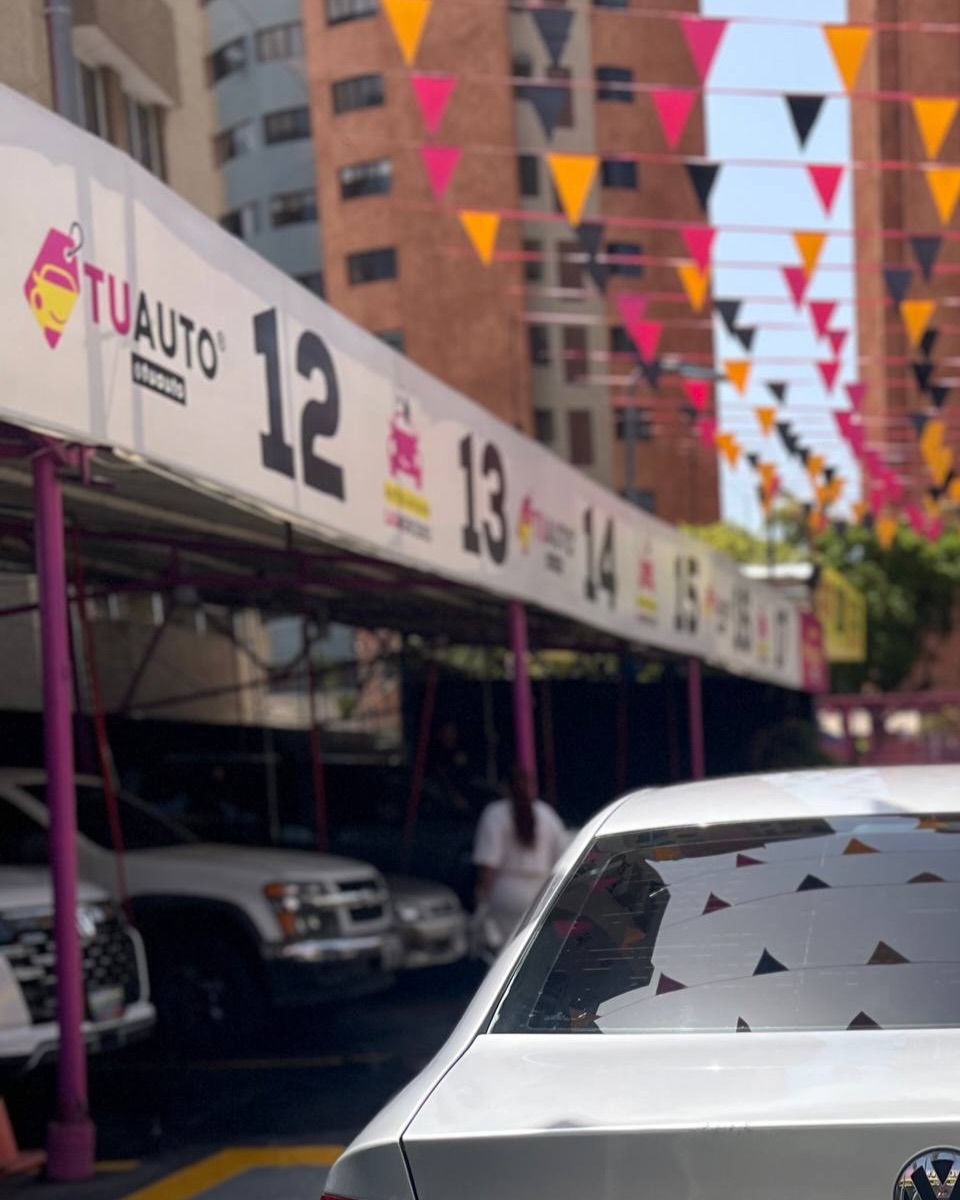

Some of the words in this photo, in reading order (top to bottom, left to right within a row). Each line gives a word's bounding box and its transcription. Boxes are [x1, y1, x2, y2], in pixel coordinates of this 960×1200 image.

[253, 306, 346, 502] 12
[460, 432, 508, 566] 13
[583, 507, 617, 611] 14
